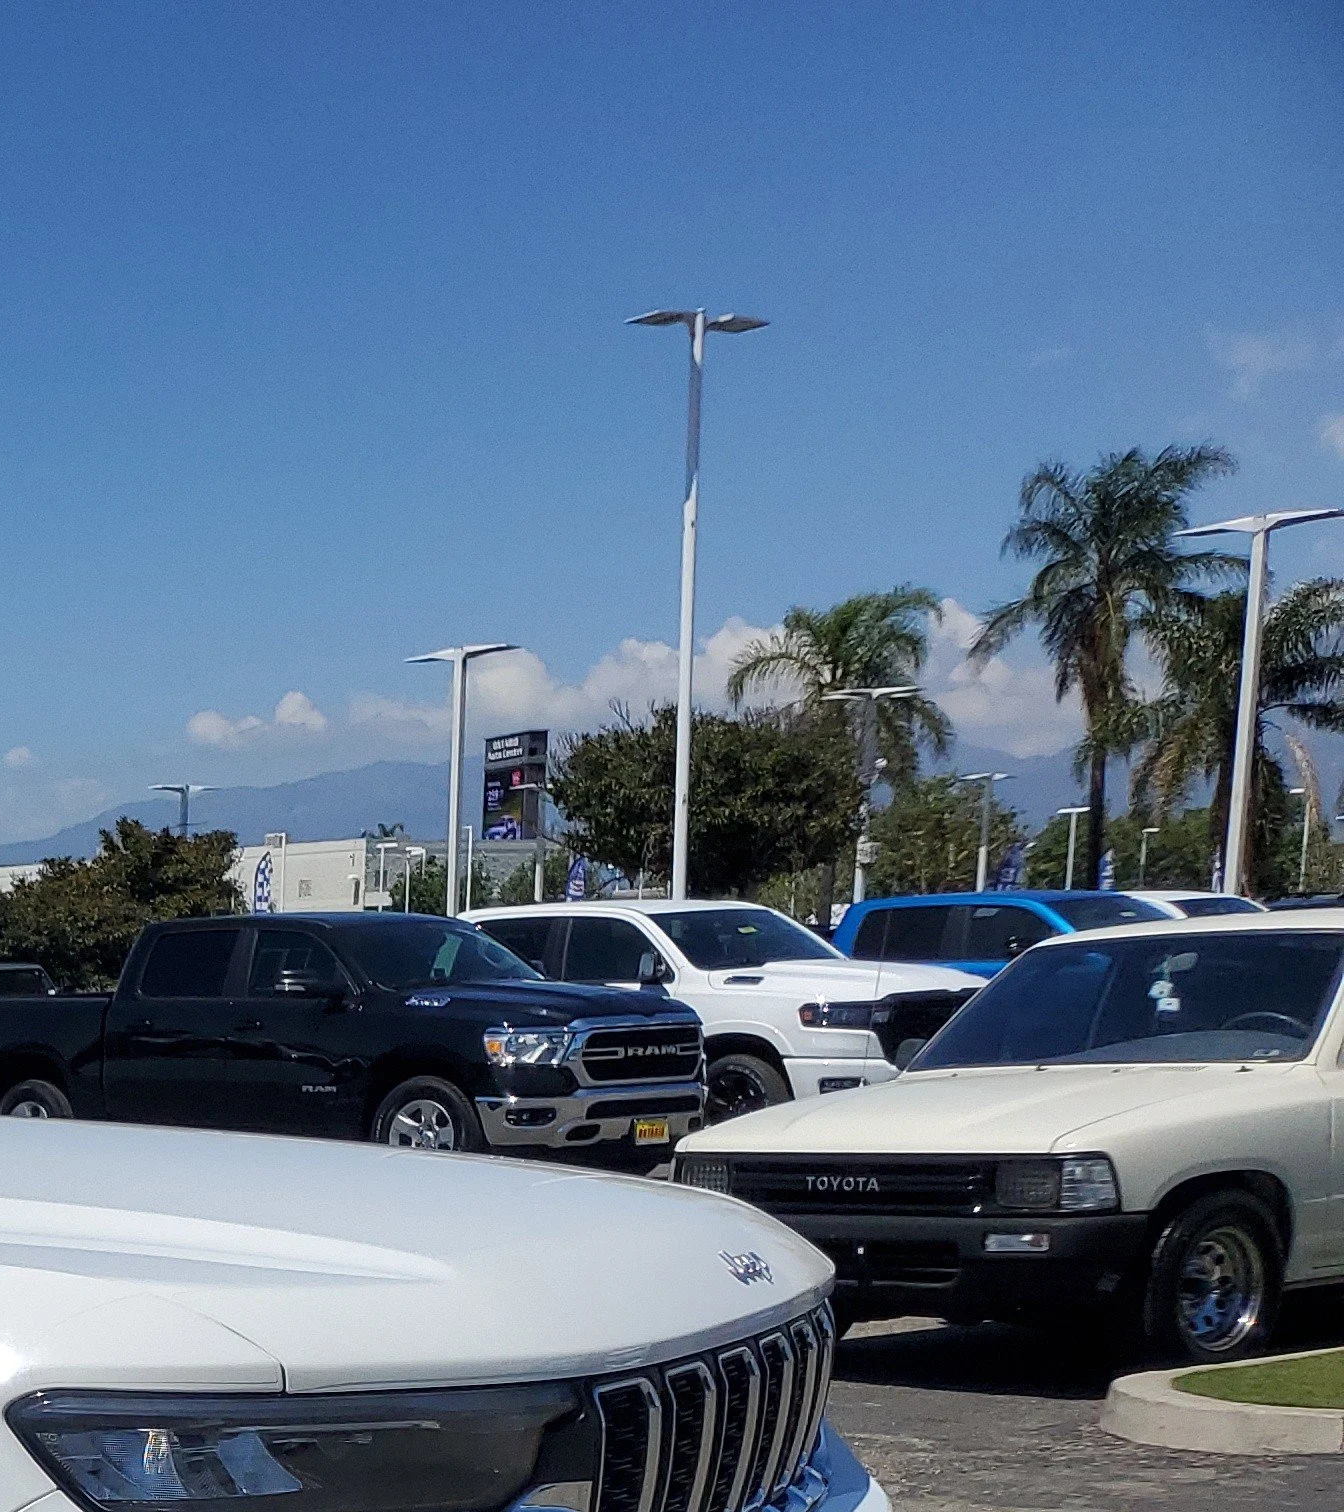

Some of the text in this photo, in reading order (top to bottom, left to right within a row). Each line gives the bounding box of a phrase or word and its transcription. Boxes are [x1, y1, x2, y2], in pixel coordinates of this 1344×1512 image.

[627, 1044, 677, 1057] RAM
[301, 1084, 337, 1093] RAM
[805, 1176, 880, 1192] TOYOTA
